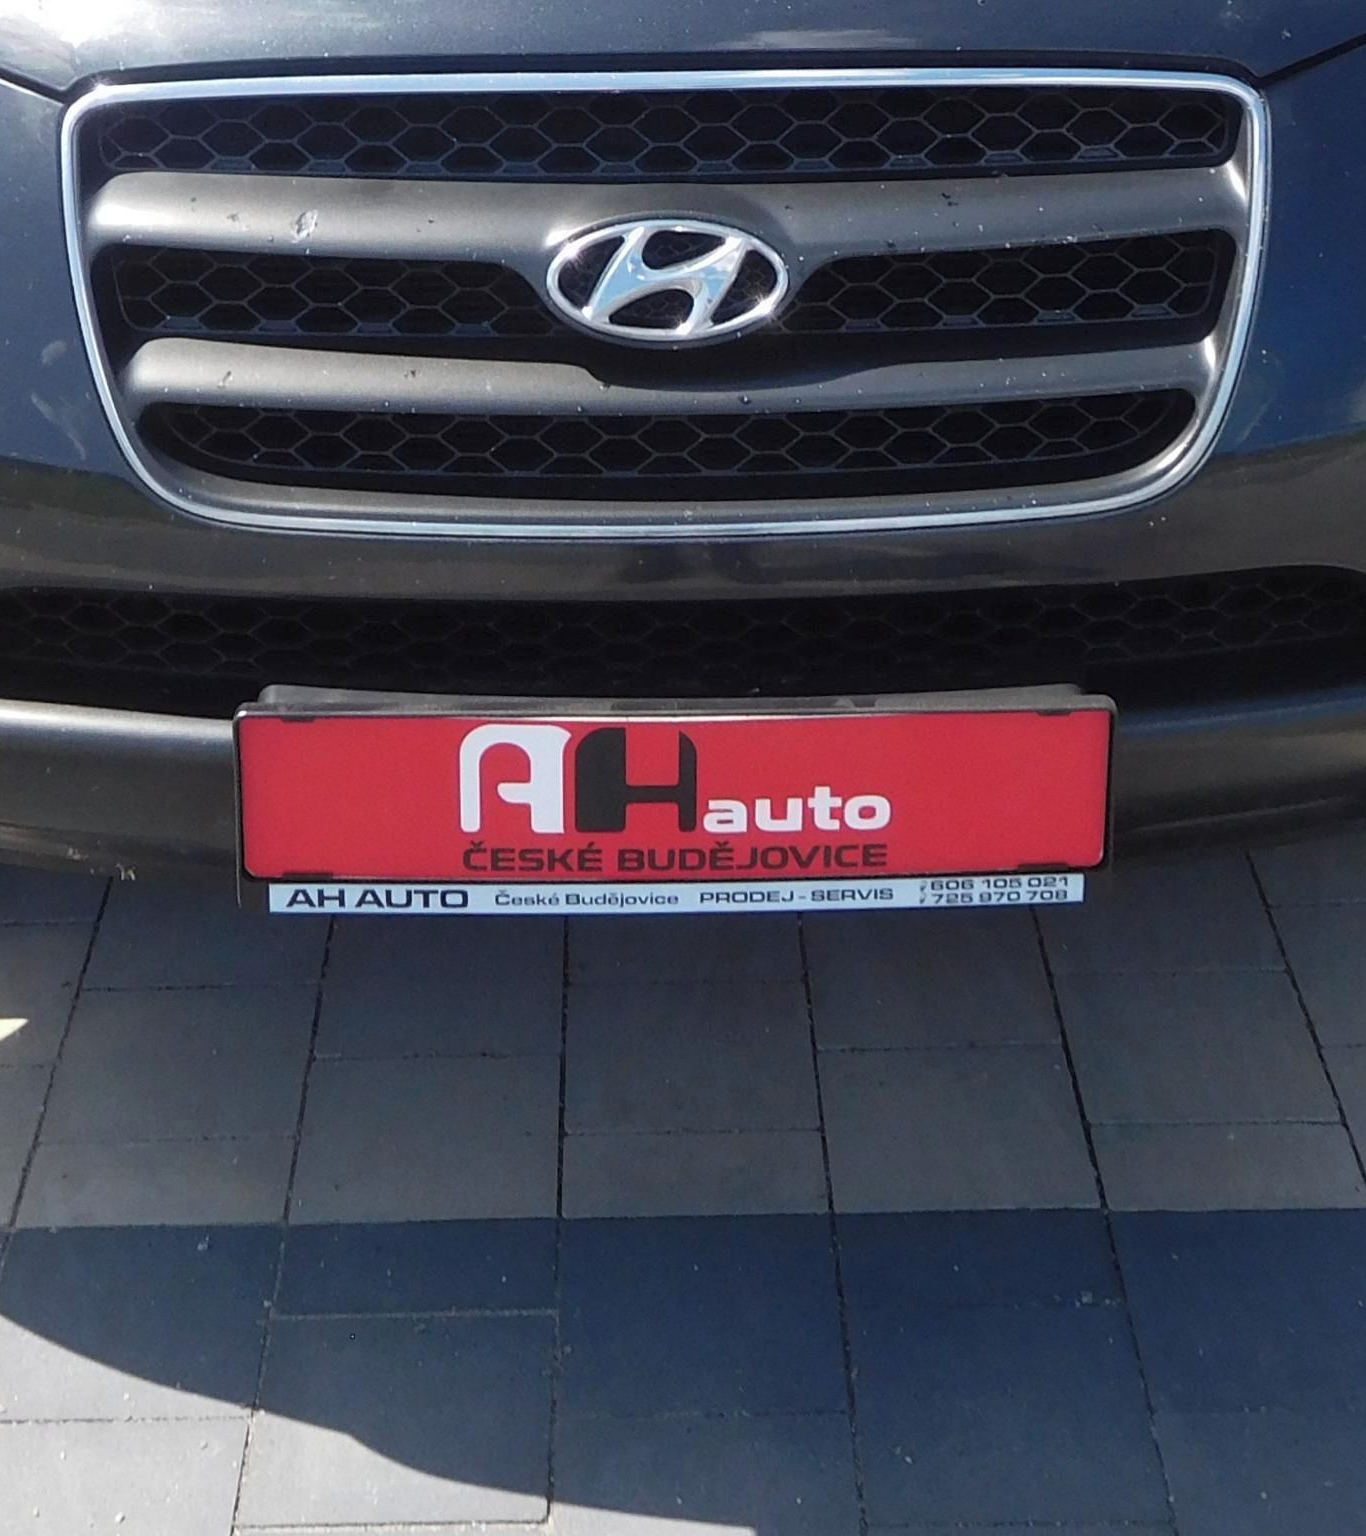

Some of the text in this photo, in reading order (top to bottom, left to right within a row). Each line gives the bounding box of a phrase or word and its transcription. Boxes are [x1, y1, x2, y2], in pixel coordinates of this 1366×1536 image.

[462, 840, 888, 872] ČESKÉ BUDĚJOVICE
[981, 877, 1022, 890] 105
[1028, 875, 1068, 888] 021
[286, 888, 346, 908] AH
[354, 888, 469, 909] AUTO
[494, 889, 559, 907] České
[564, 892, 679, 908] Budějovice
[931, 889, 1068, 905] 725 970 708
